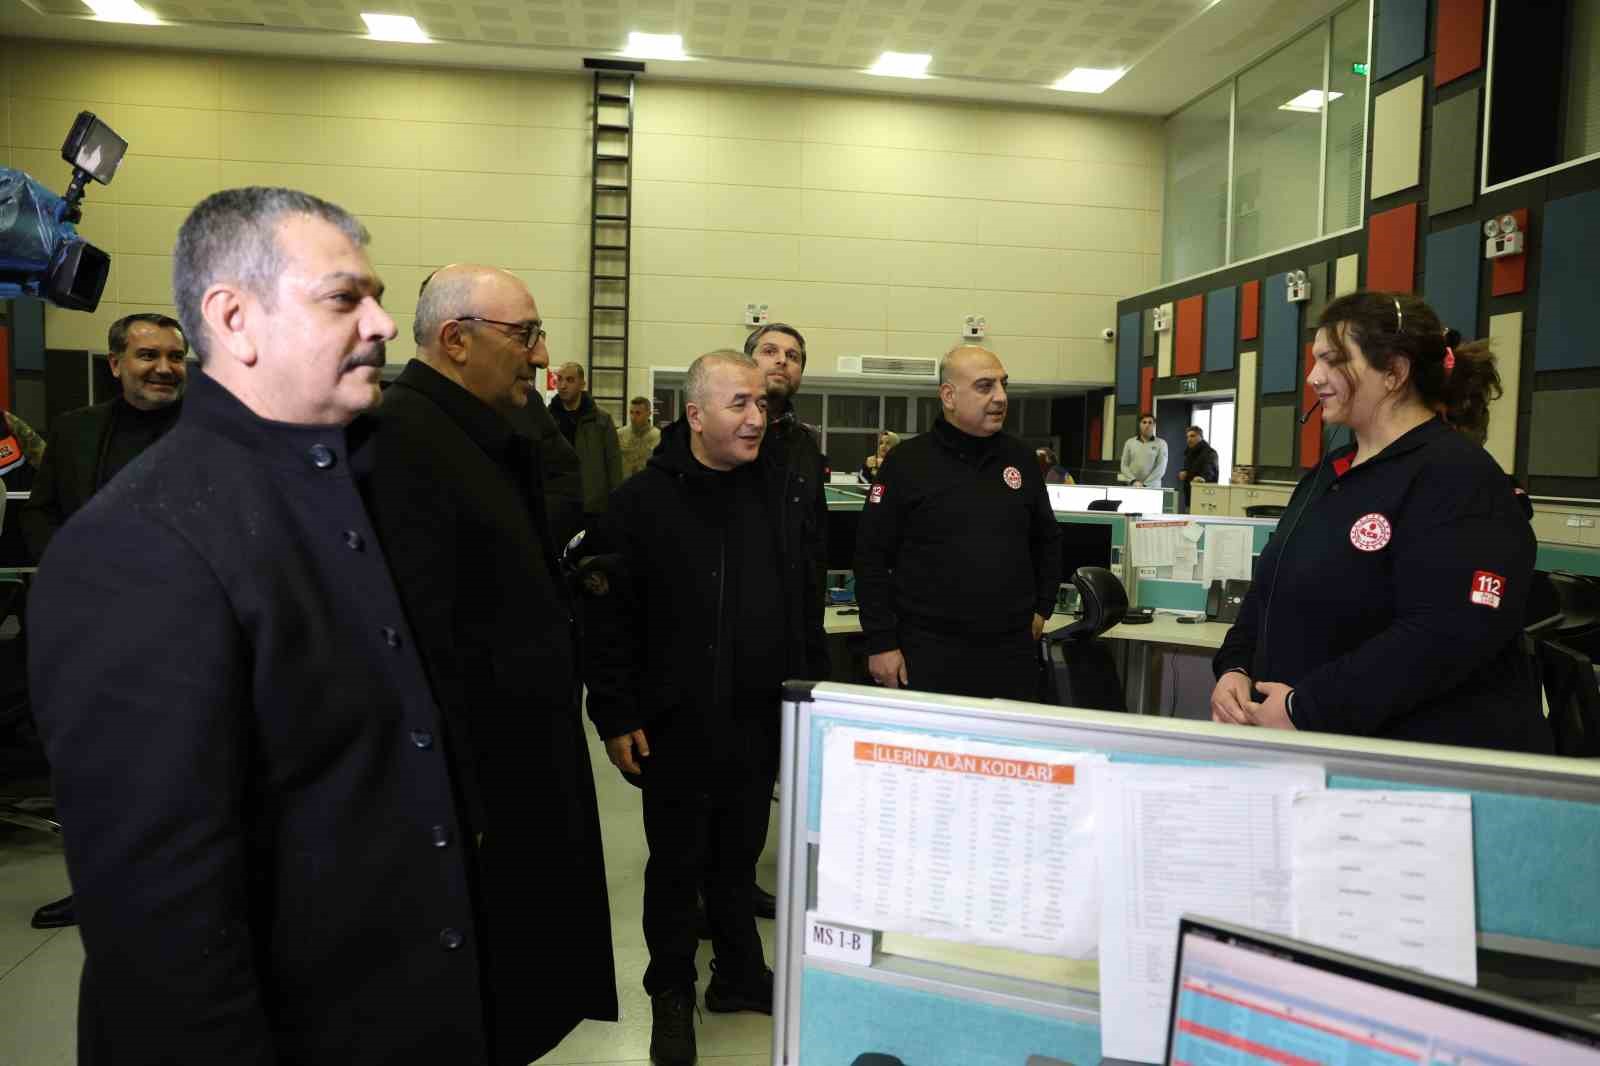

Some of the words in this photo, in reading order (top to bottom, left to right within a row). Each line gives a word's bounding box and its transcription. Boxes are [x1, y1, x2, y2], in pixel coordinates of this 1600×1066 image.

[1478, 575, 1500, 595] 112
[933, 751, 977, 772] ALAN
[813, 925, 833, 946] MS
